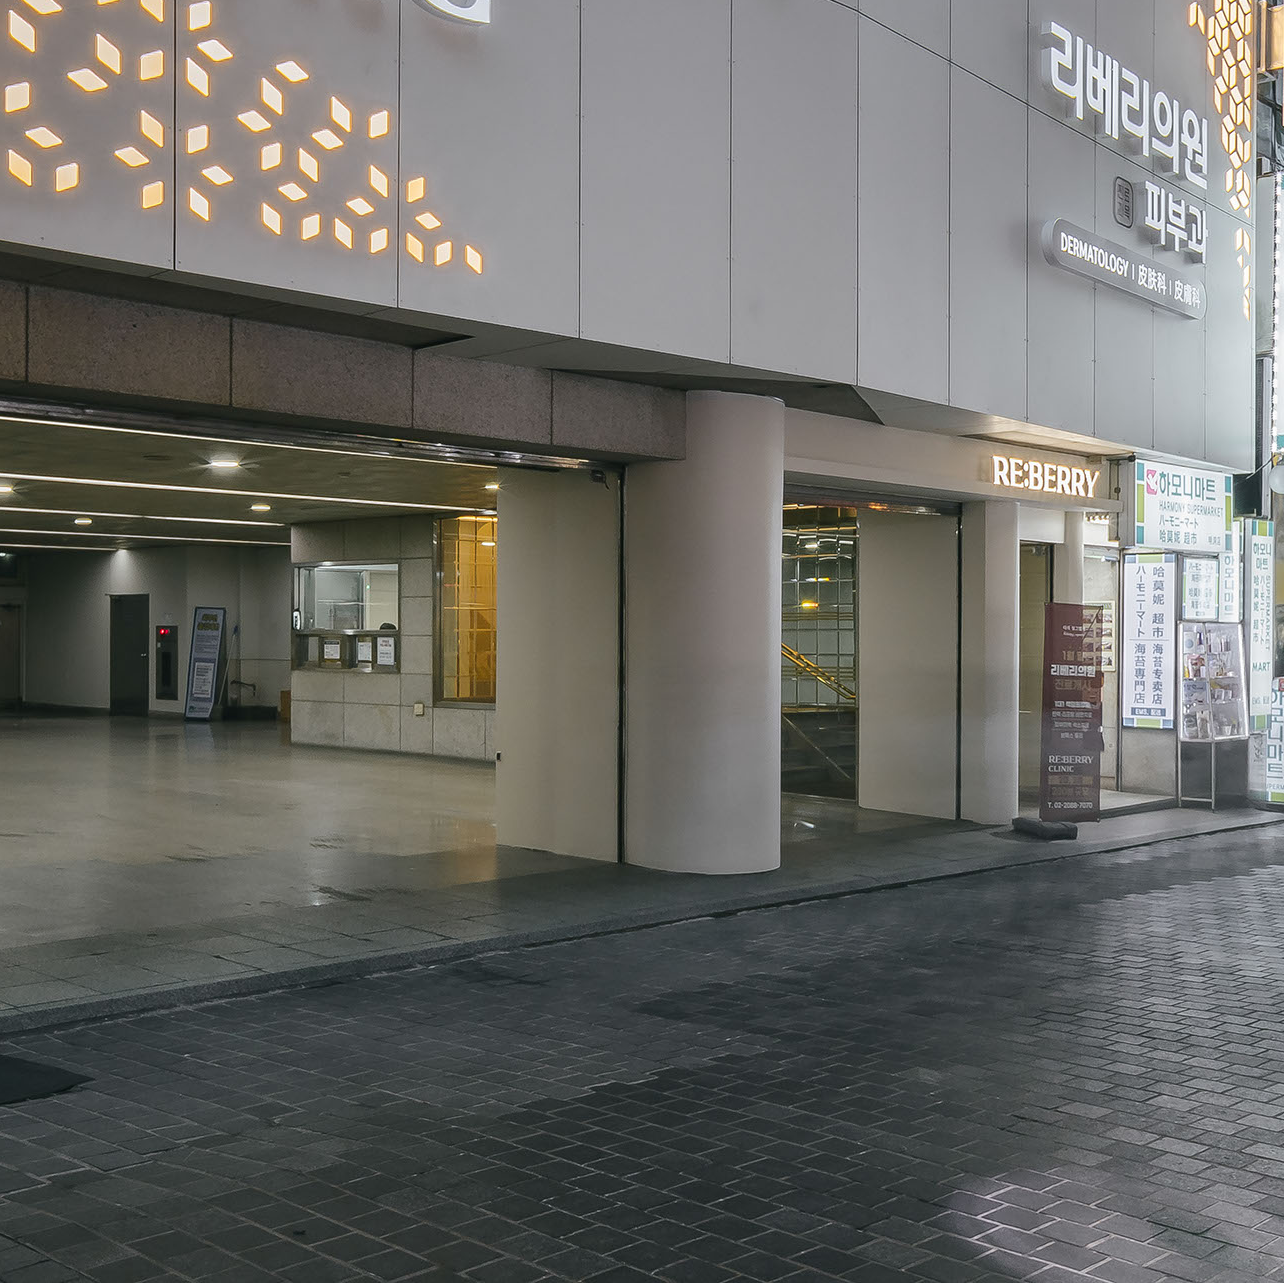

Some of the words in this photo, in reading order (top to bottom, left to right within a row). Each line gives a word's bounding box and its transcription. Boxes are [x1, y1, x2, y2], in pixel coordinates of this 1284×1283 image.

[1049, 20, 1208, 190] 리베리의원
[1144, 180, 1209, 264] 피부과
[1060, 231, 1129, 277] DERMATOLOGY
[991, 454, 1100, 499] RE:BERRY
[1159, 471, 1216, 501] 하모니마트
[1159, 500, 1185, 513] HARMONY
[1187, 504, 1223, 517] SUPERMARKET
[1136, 565, 1146, 638] ハーモニーマート
[1050, 664, 1096, 677] 리베리의원
[1252, 661, 1271, 672] MART
[1048, 755, 1094, 764] RE:BERRY
[1048, 765, 1075, 773] CLINIC
